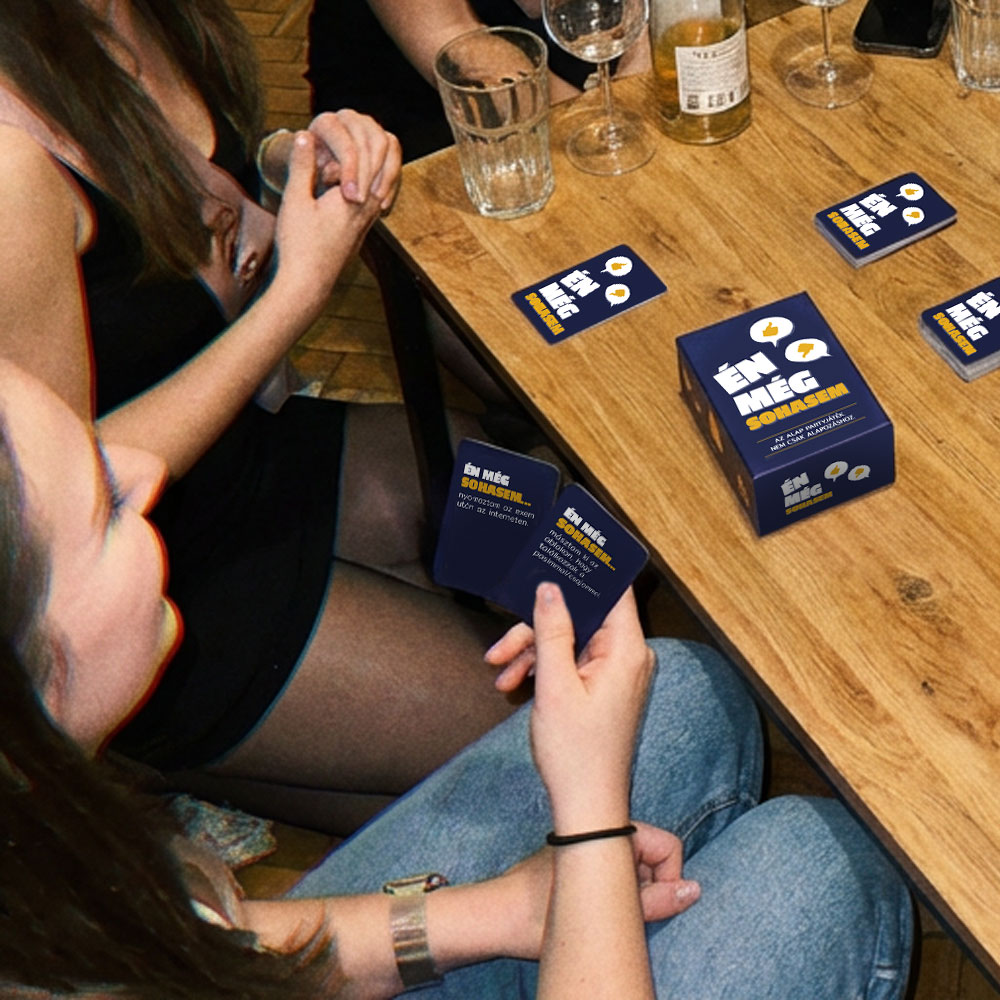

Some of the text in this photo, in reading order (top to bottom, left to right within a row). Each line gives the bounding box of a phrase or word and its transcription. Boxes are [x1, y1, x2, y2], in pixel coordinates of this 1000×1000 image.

[839, 202, 882, 237] MÉG
[858, 193, 898, 218] ÉN
[827, 212, 870, 250] SOHASEM
[560, 270, 600, 298] ÉN
[524, 292, 565, 335] SOHASEM
[538, 282, 580, 320] MÉG
[932, 312, 977, 356] SOHASEM
[945, 302, 989, 341] MÉG
[712, 350, 779, 395] ÉN
[732, 369, 820, 416] MÉG
[746, 382, 850, 431] SOHASEM
[774, 411, 845, 443] AZ ALAP PARTYJÁTÉK
[770, 443, 786, 451] NEM
[787, 434, 805, 445] CSAK
[463, 462, 510, 486] ÉN MÉG
[780, 472, 810, 496] ÉN
[784, 483, 823, 508] MÉG
[785, 491, 833, 516] SOHASEM
[477, 507, 486, 515] az
[503, 505, 512, 513] az
[515, 509, 535, 520] exem
[563, 506, 608, 547] ÉN MÉG
[574, 558, 592, 574] hogy
[582, 554, 590, 562] ki
